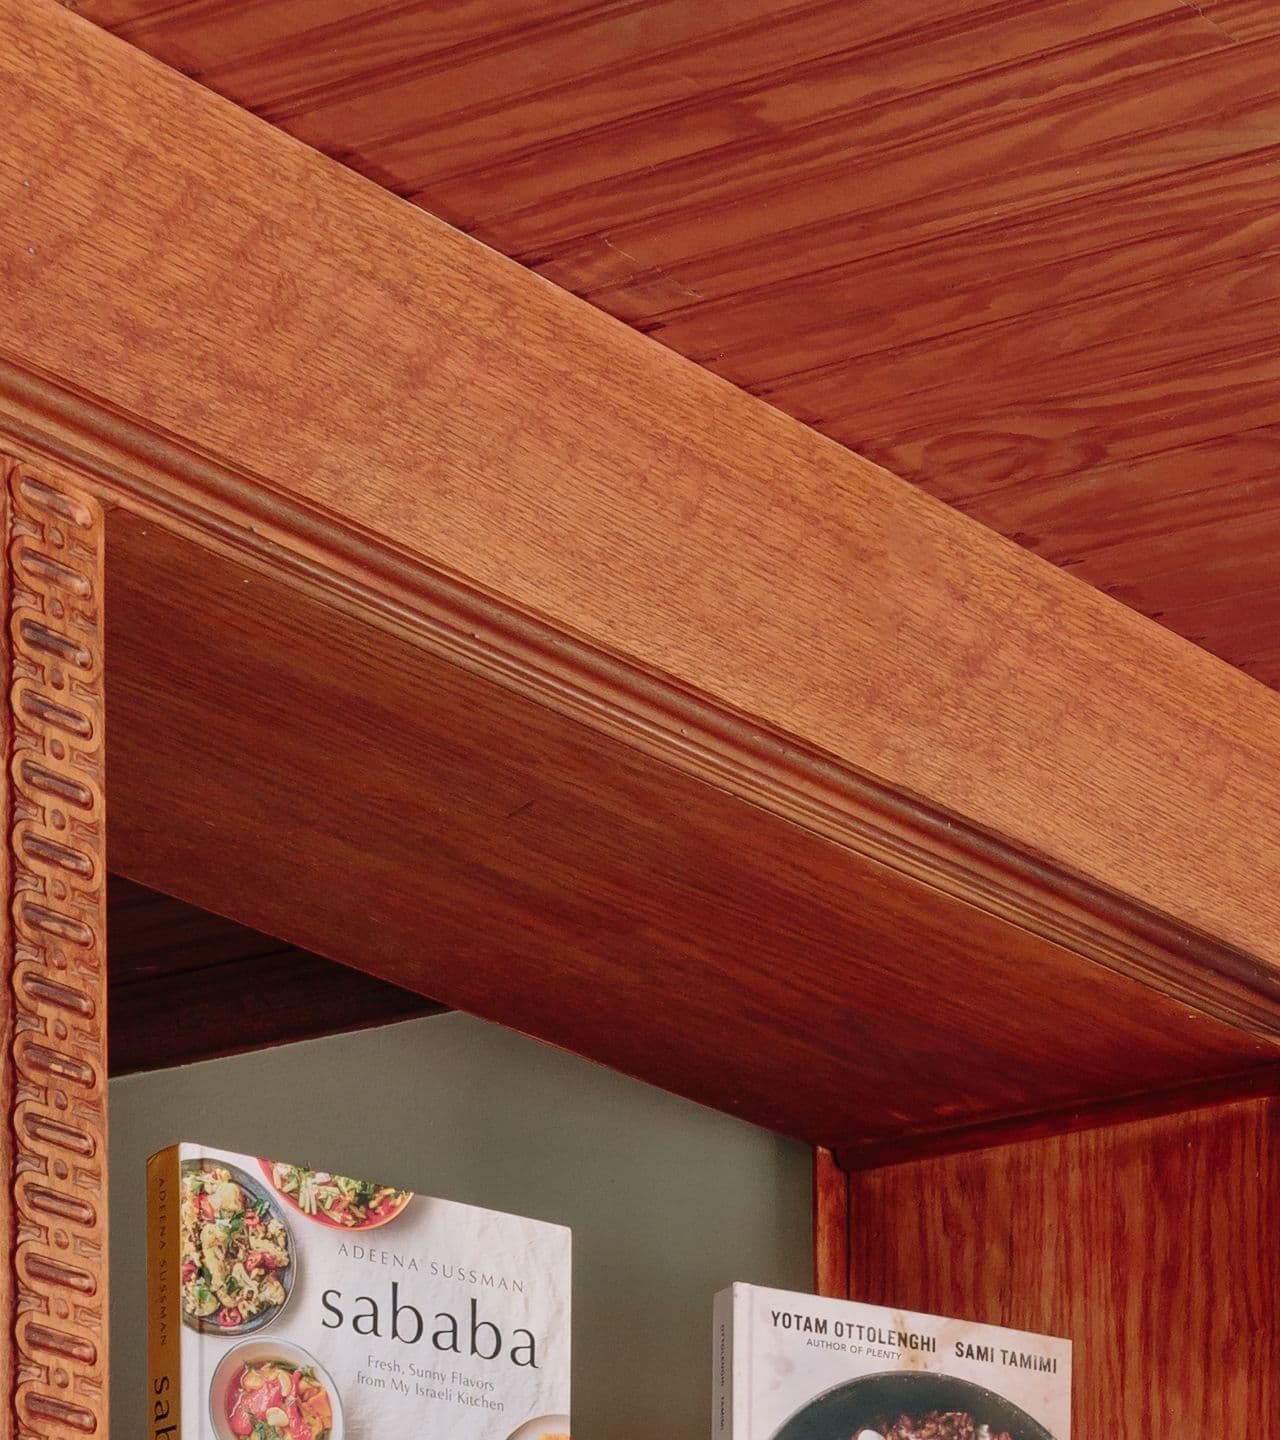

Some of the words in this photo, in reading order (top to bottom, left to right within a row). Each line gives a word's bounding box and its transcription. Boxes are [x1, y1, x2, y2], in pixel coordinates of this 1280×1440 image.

[338, 1243, 418, 1271] ADEENA
[430, 1262, 524, 1293] SUSSMAN
[321, 1281, 540, 1369] sababa
[771, 1311, 828, 1334] YOTAM
[834, 1321, 937, 1353] OTTOLENGHI
[806, 1338, 847, 1352] AUTHOR
[850, 1345, 864, 1355] OF
[866, 1347, 902, 1361] PLENTY
[955, 1341, 995, 1363] SAMI
[1000, 1349, 1058, 1374] TAMIMI
[356, 1371, 386, 1388] from
[391, 1378, 409, 1396] My
[415, 1383, 452, 1402] Israeli
[458, 1392, 505, 1411] Kitchen
[367, 1355, 405, 1375] Fresh,
[408, 1363, 447, 1384] Sunny
[451, 1372, 495, 1391] Flavors
